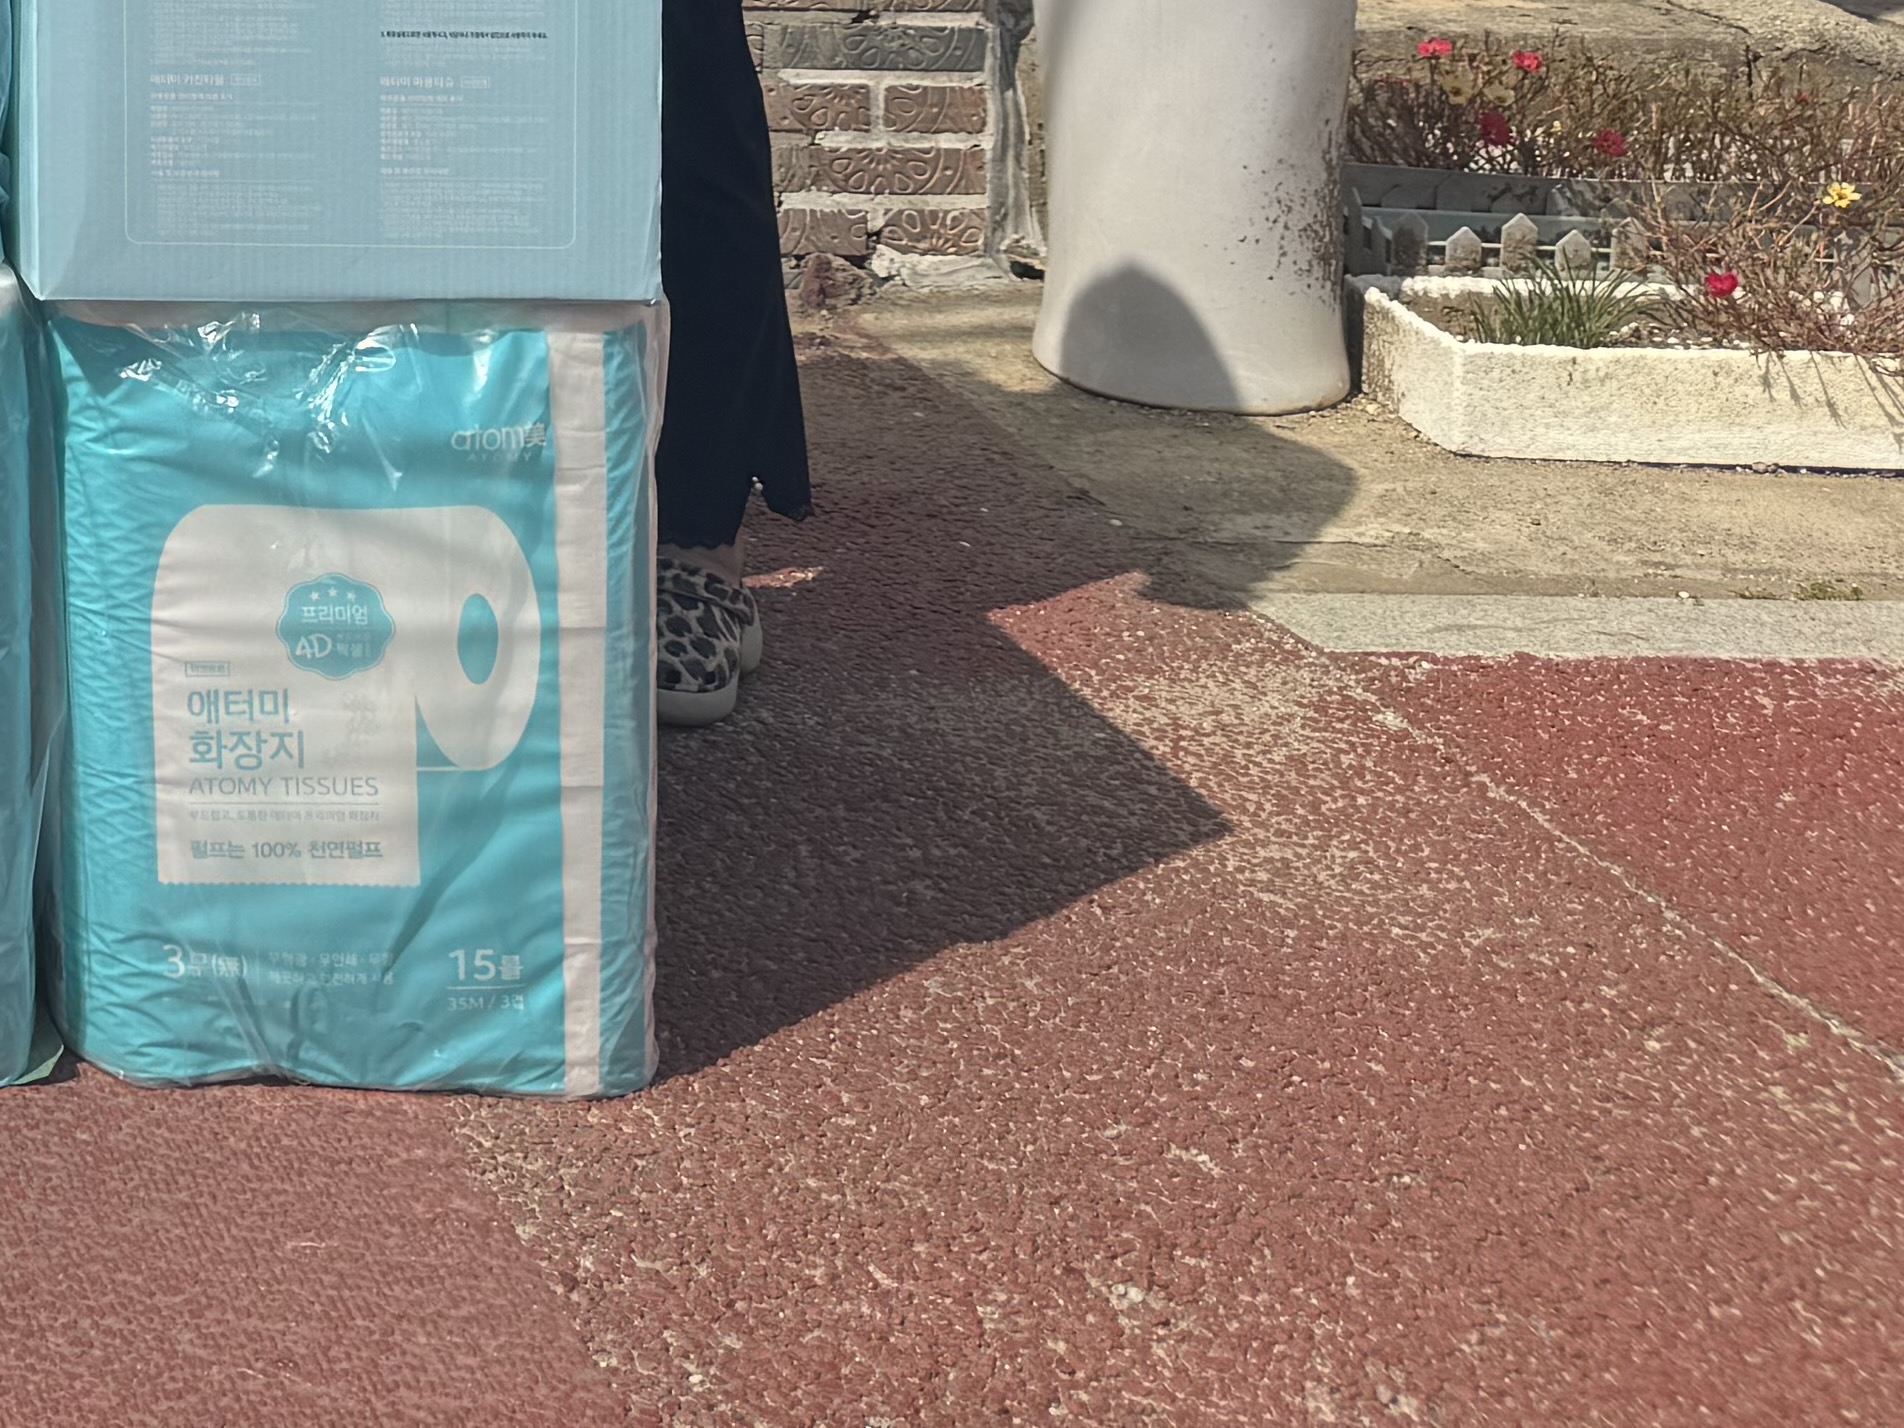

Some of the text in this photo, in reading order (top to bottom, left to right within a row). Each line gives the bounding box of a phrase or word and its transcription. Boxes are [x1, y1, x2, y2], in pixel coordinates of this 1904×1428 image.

[301, 605, 368, 626] 프리미엄
[295, 633, 332, 659] 4D
[186, 688, 291, 725] 애터미
[187, 727, 306, 771] 화장지
[189, 777, 379, 797] ATOMY TISSUES
[191, 841, 383, 859] 펄프는 100% 천연펄프
